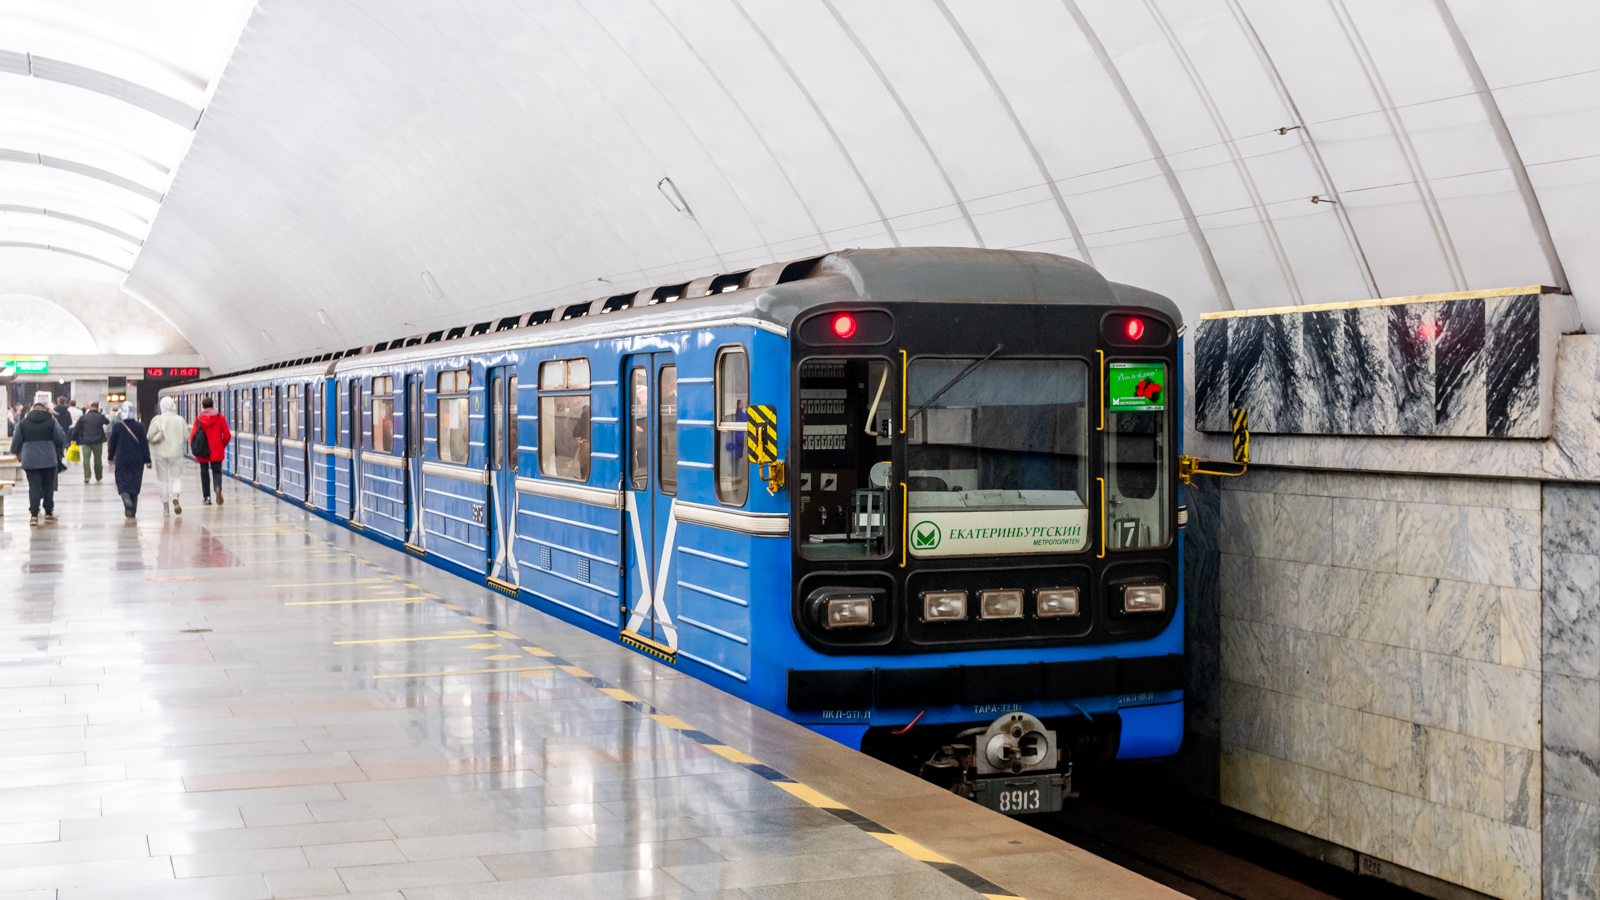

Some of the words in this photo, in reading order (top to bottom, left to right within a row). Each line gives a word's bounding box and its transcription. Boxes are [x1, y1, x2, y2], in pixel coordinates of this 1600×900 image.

[949, 523, 1082, 540] ЕКАТЕРИНБУРГСКИЙ
[1032, 538, 1081, 546] МЕТРОПОЛИТЕН
[999, 789, 1040, 812] 8913
